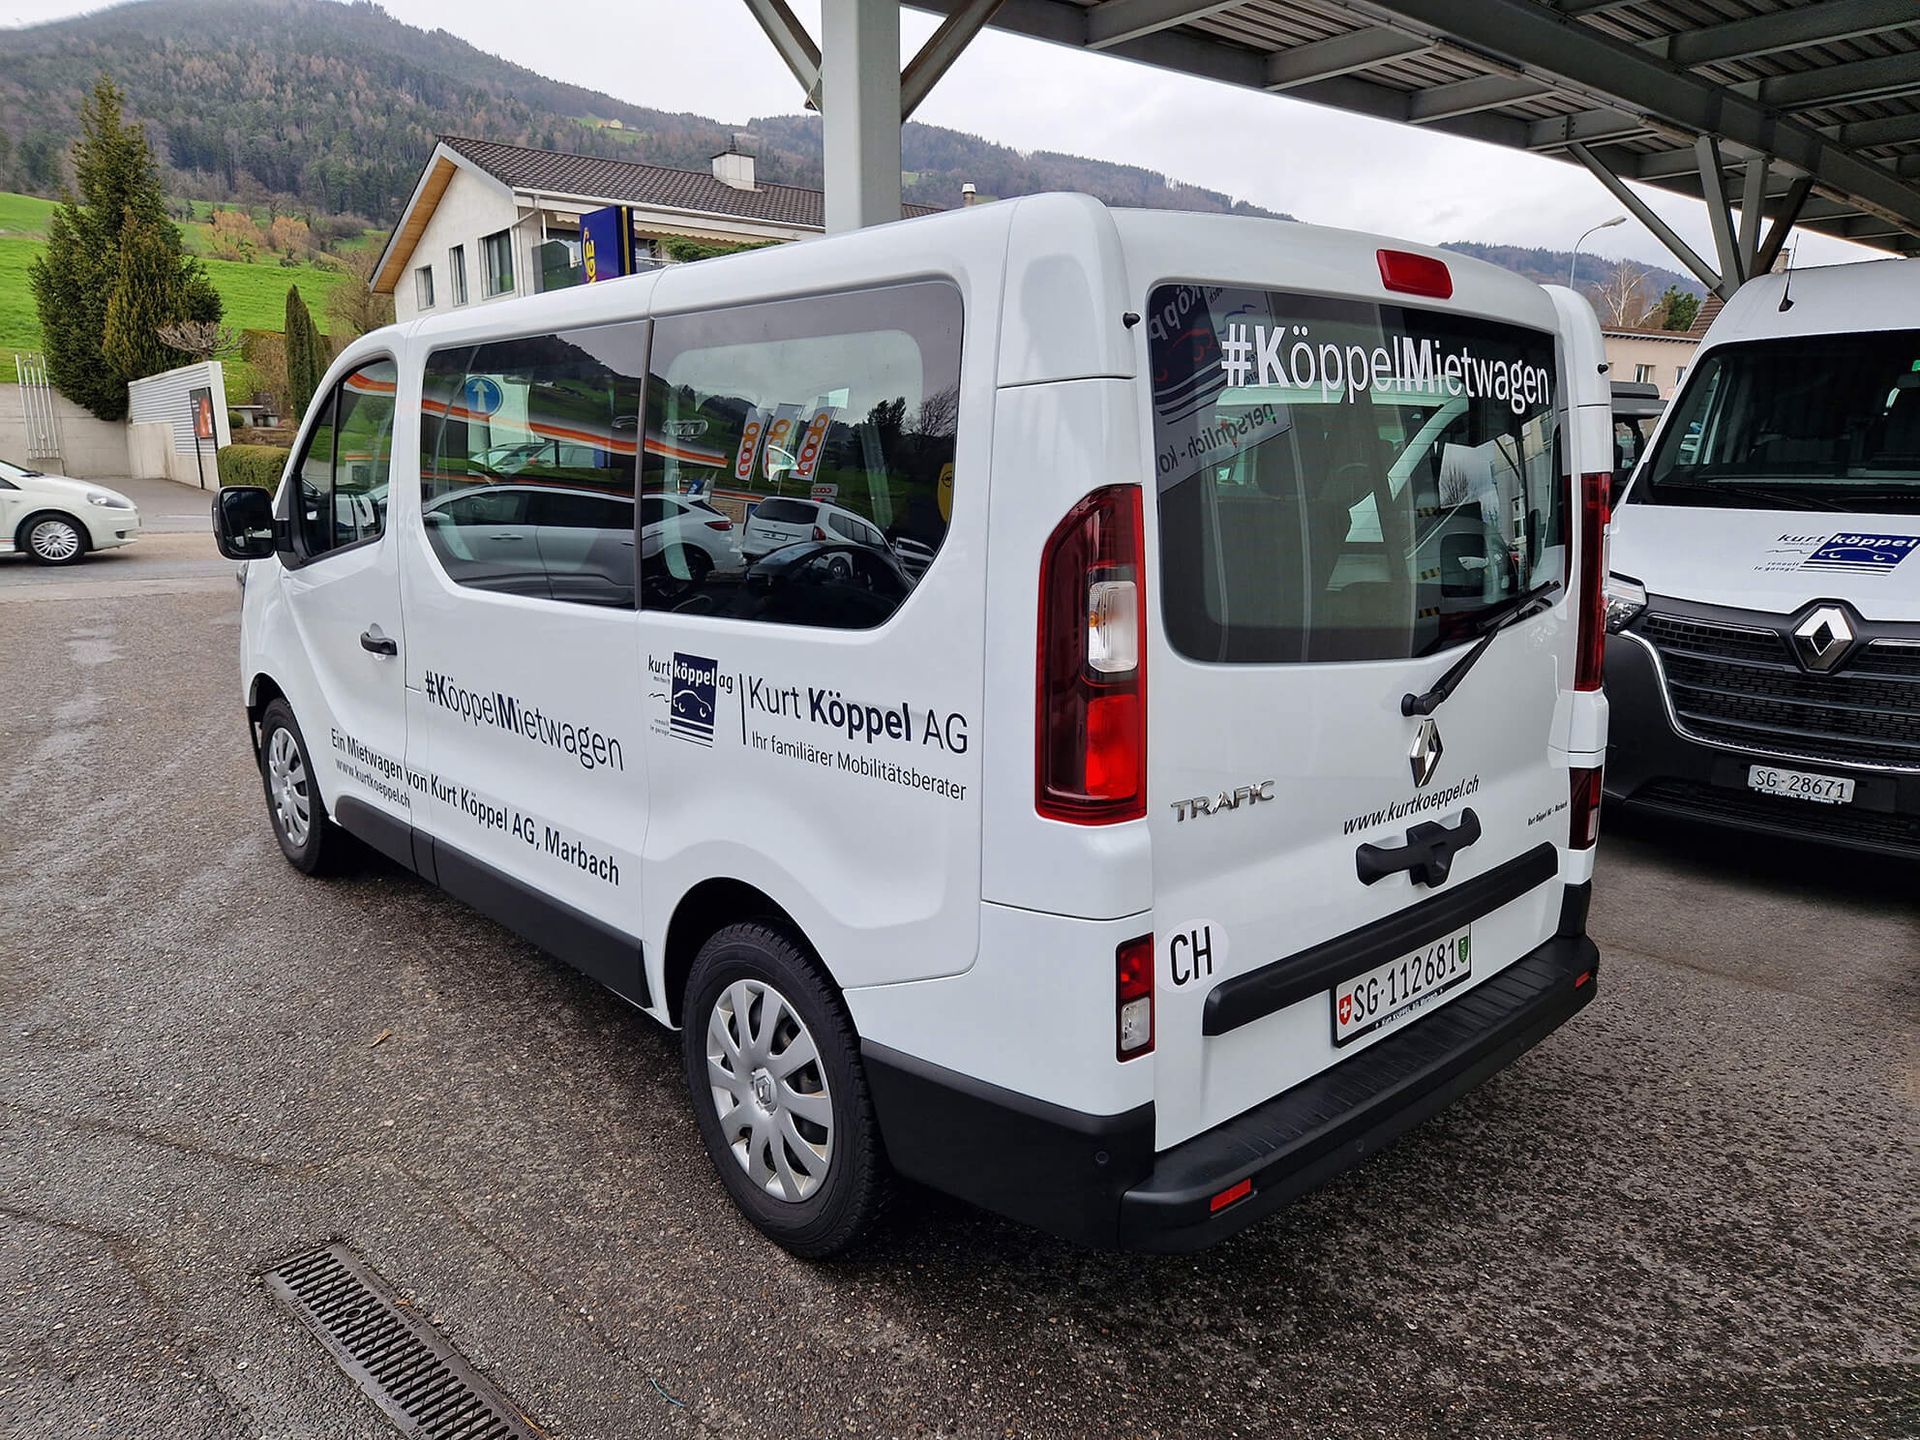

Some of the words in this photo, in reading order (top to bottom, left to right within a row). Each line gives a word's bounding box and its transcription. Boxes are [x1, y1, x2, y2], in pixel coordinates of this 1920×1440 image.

[1220, 323, 1550, 414] #KöppelMietwagen
[648, 654, 671, 676] kurt
[674, 660, 716, 688] köppel
[719, 674, 733, 694] ag
[425, 670, 624, 771] #KöppelMietwagen
[749, 676, 801, 720] Kurt
[808, 687, 912, 744] Köppel
[922, 709, 968, 754] AG
[752, 731, 768, 750] Ihr
[771, 736, 833, 767] familiärer
[837, 752, 967, 801] Mobilitätsberater
[331, 728, 346, 752] Ein
[347, 735, 403, 780] Mietwagen
[406, 770, 427, 793] von
[430, 773, 457, 807] Kurt
[461, 787, 508, 831] Köppel
[512, 812, 541, 850] AG,
[545, 826, 620, 886] Marbach
[1170, 780, 1275, 823] TRAFIC
[1344, 774, 1480, 835] www.kurtkoeppel.ch
[1169, 926, 1214, 986] CH
